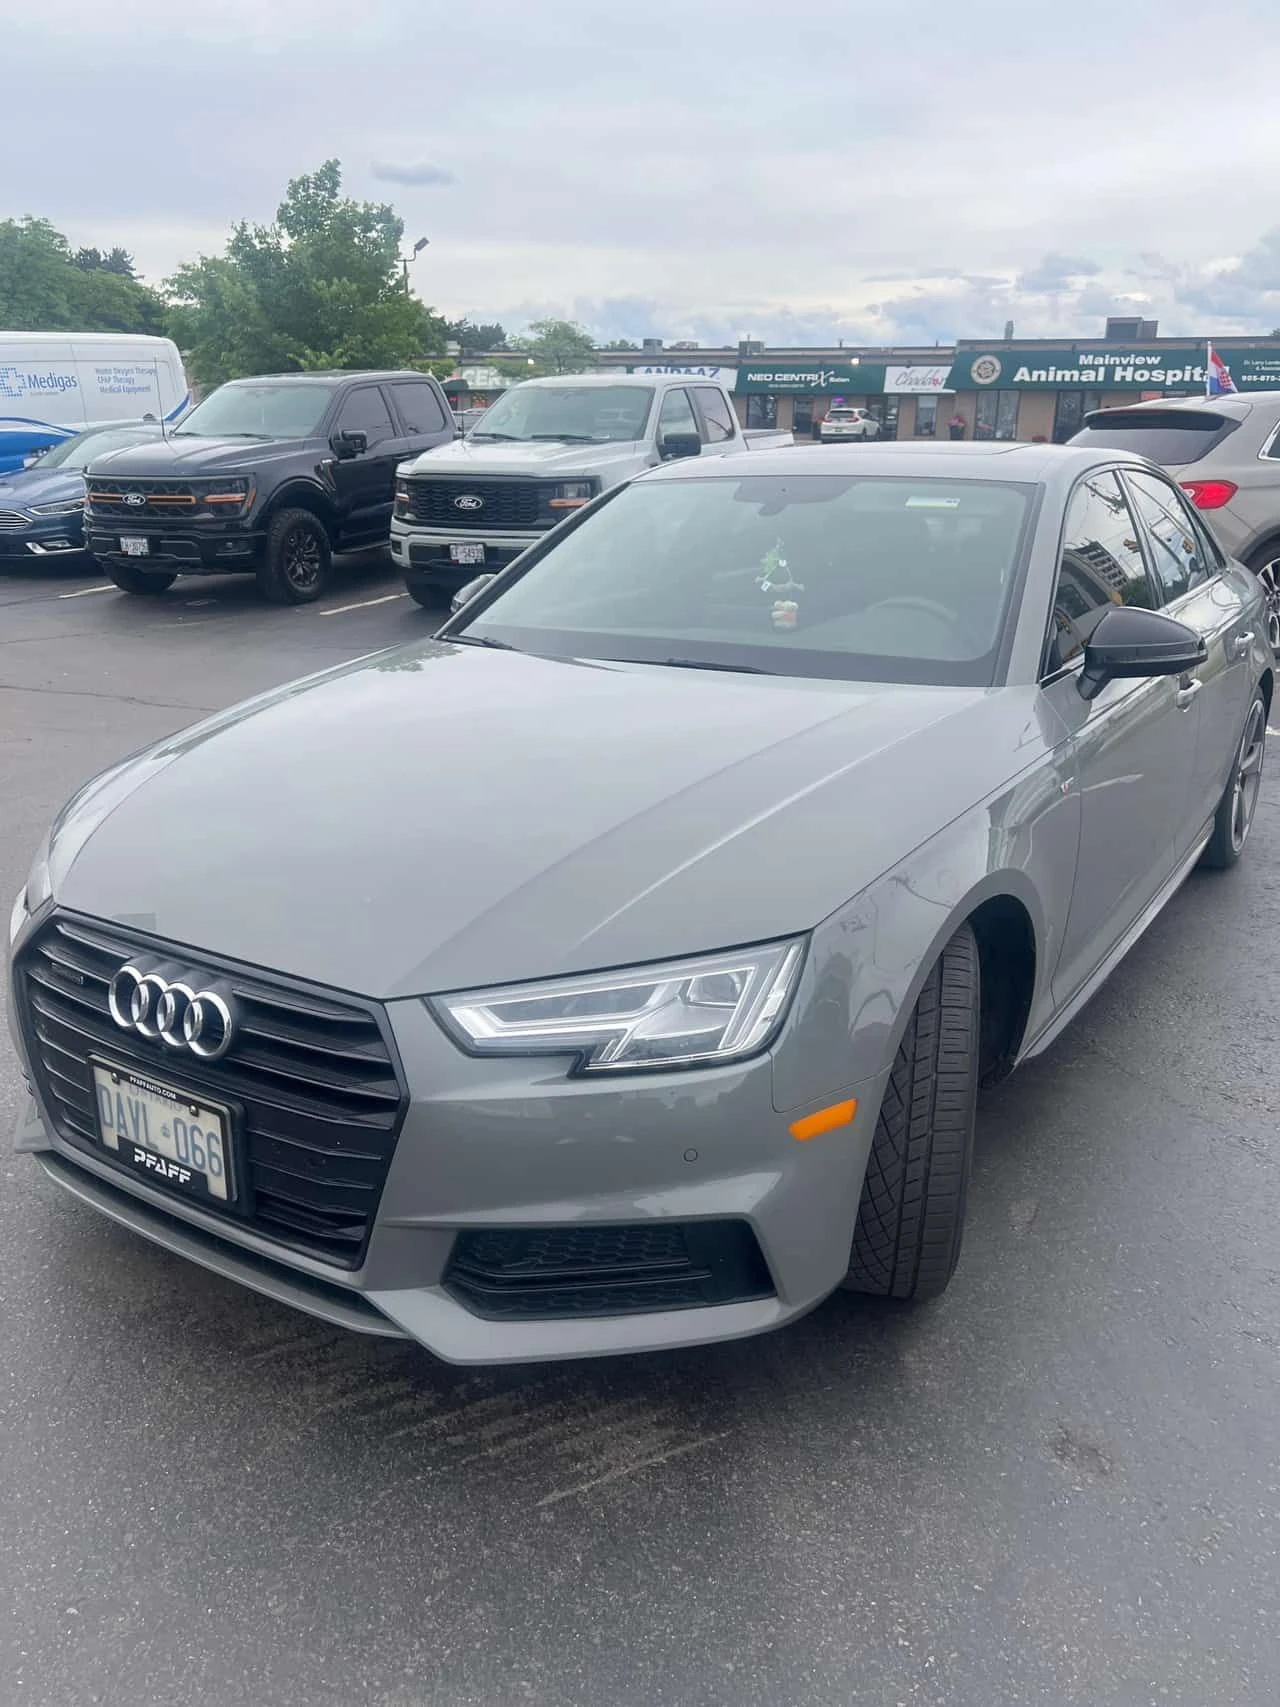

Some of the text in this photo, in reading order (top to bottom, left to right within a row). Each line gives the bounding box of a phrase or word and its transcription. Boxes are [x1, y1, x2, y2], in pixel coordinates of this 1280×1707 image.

[1079, 354, 1161, 365] Mainview
[28, 371, 78, 392] Medigas
[747, 373, 773, 382] NEO
[774, 370, 834, 387] CENTRIX
[1013, 366, 1230, 386] Animal Hospit
[133, 1147, 192, 1184] PFAFF
